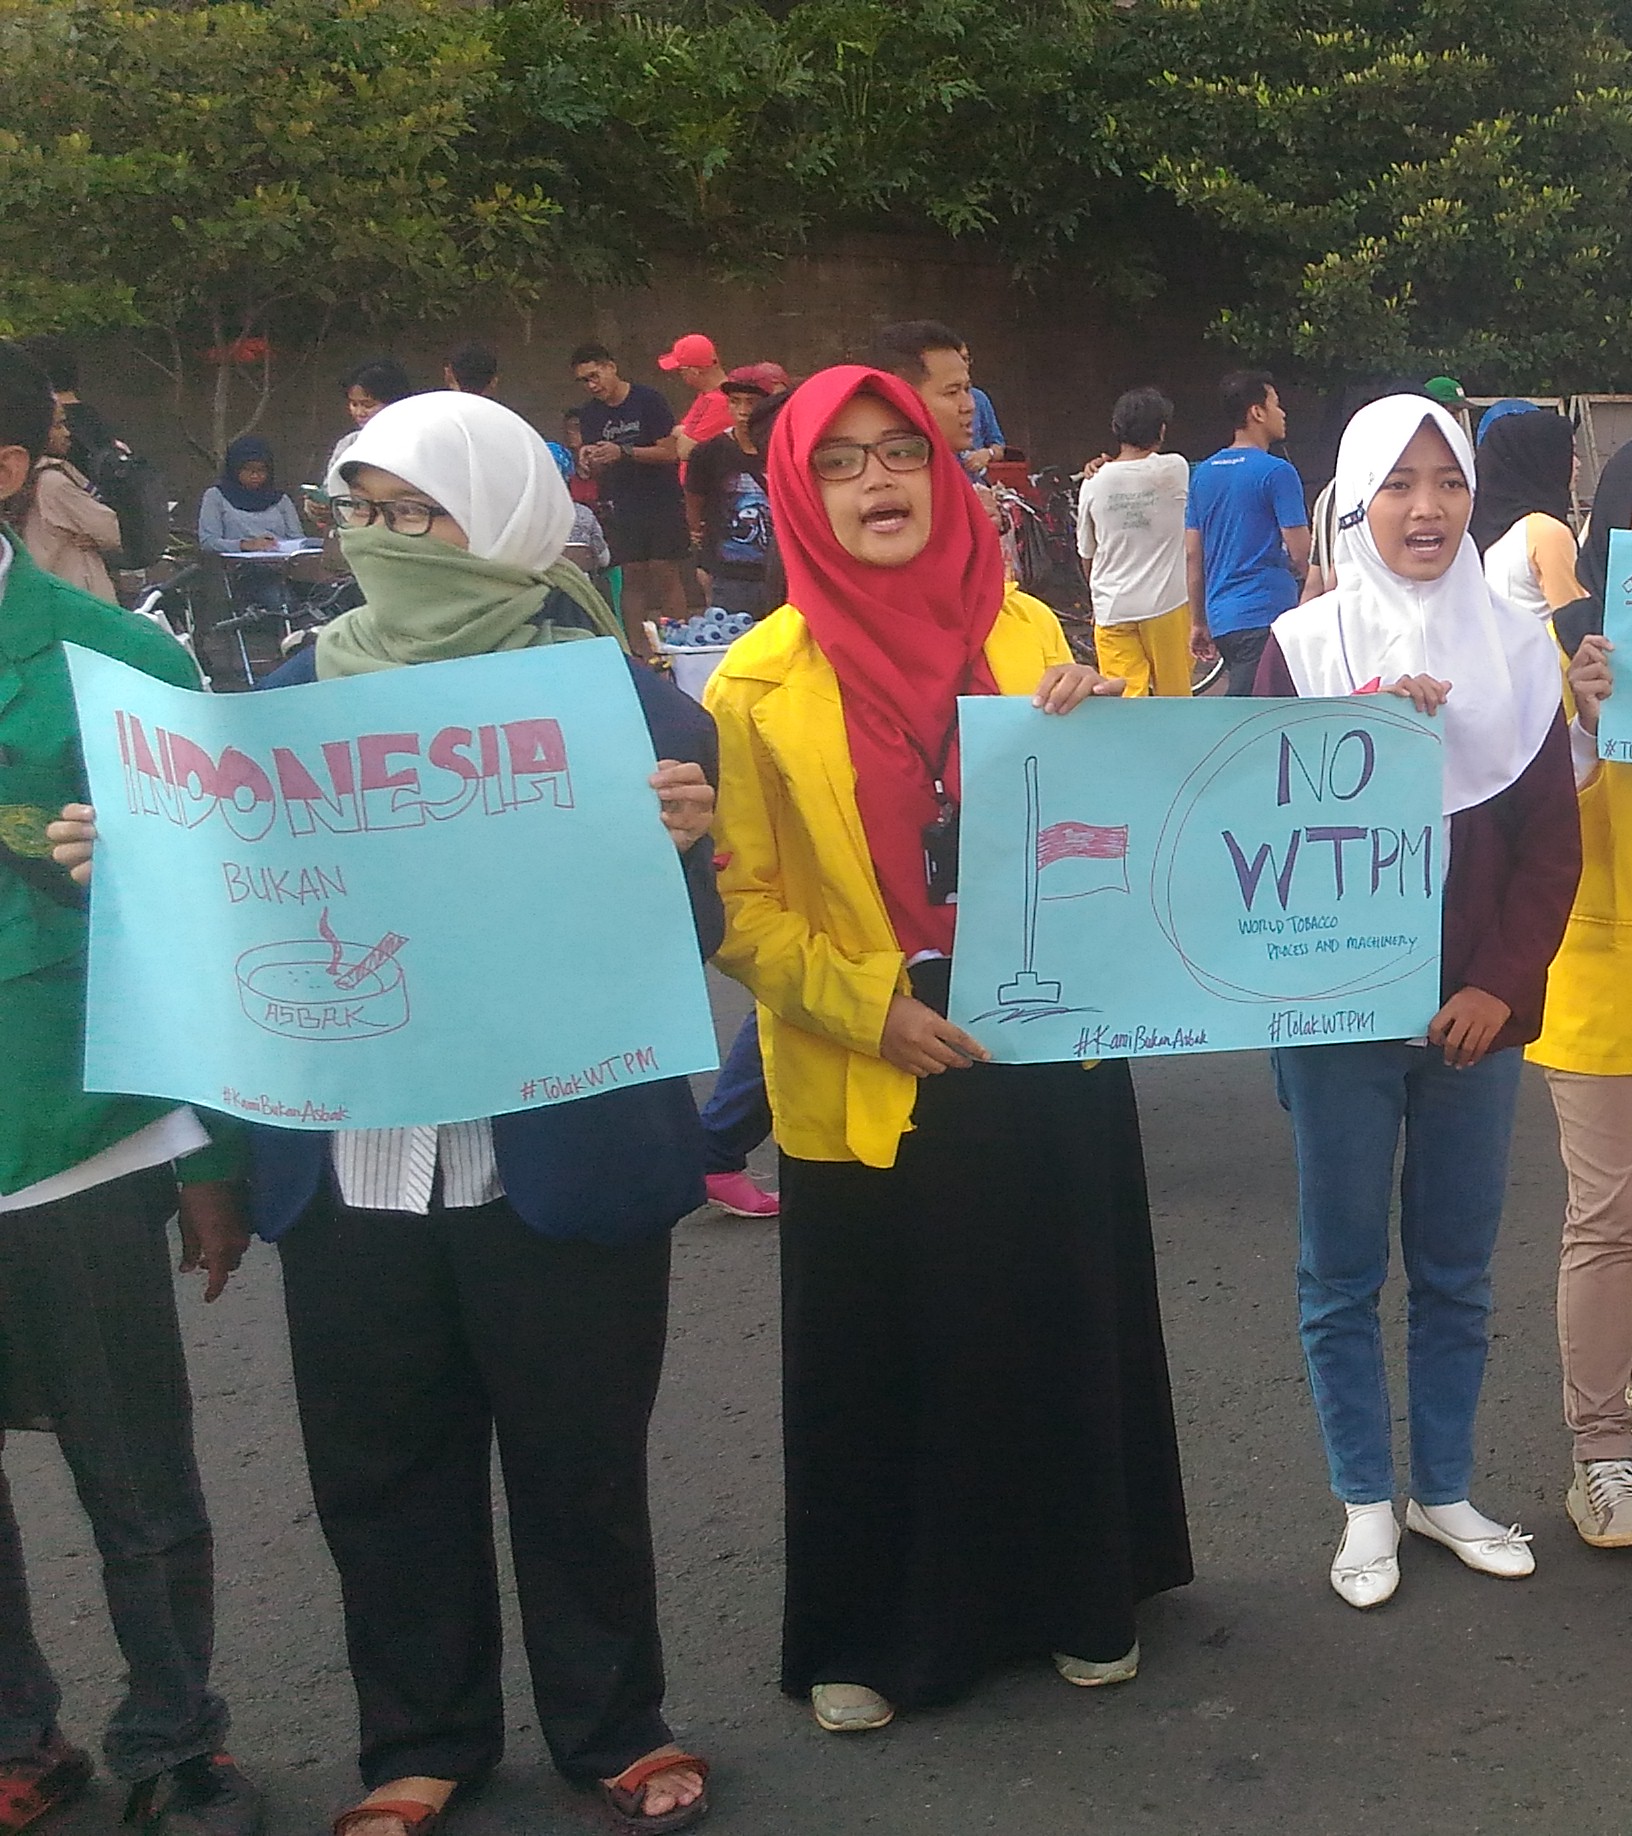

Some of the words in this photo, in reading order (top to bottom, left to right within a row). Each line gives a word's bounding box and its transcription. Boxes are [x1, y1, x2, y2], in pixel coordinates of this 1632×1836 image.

[115, 709, 575, 842] INDONESIA
[1276, 729, 1375, 807] NO
[222, 861, 348, 904] BUKAN
[1221, 825, 1433, 912] WTPM
[1237, 916, 1285, 935] WORLD
[1287, 915, 1339, 933] TOBACCO
[1266, 942, 1309, 961] PROCESS
[1315, 938, 1340, 954] AND
[1346, 934, 1420, 955] MACHINERY
[264, 1003, 390, 1031] ASBAK
[1269, 1009, 1376, 1042] #TolakWTPM
[1072, 1025, 1208, 1058] #KamiBukanAsbak
